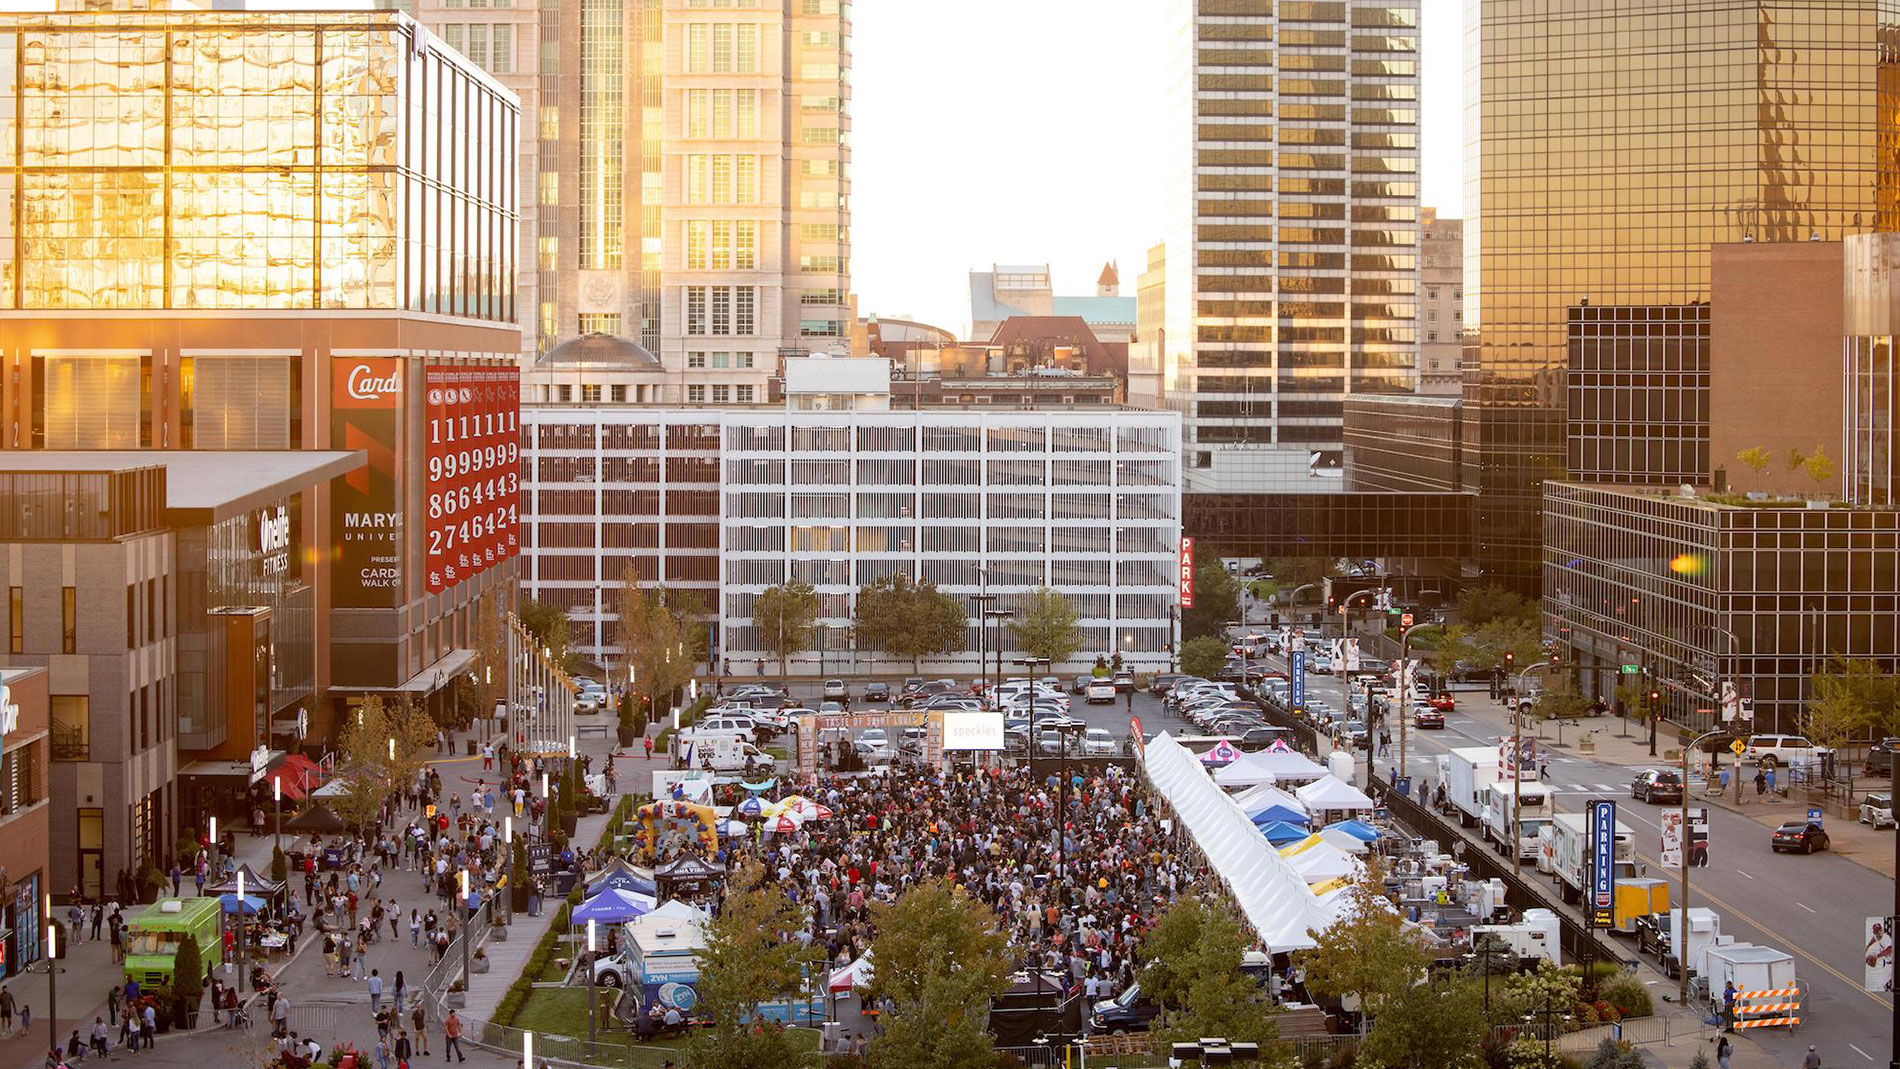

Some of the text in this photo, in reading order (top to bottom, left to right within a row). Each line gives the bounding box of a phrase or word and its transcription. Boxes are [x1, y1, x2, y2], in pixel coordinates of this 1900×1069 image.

[260, 505, 289, 554] Onelife
[262, 553, 288, 577] FITNESS
[1182, 538, 1191, 593] PARK
[361, 579, 389, 587] WALK
[826, 714, 917, 727] TASTE OF SAINT LOUIS
[953, 724, 996, 736] speckles
[698, 751, 715, 759] one
[1600, 807, 1608, 891] PARKING
[650, 974, 669, 982] ZYN
[674, 988, 693, 1002] ZYN
